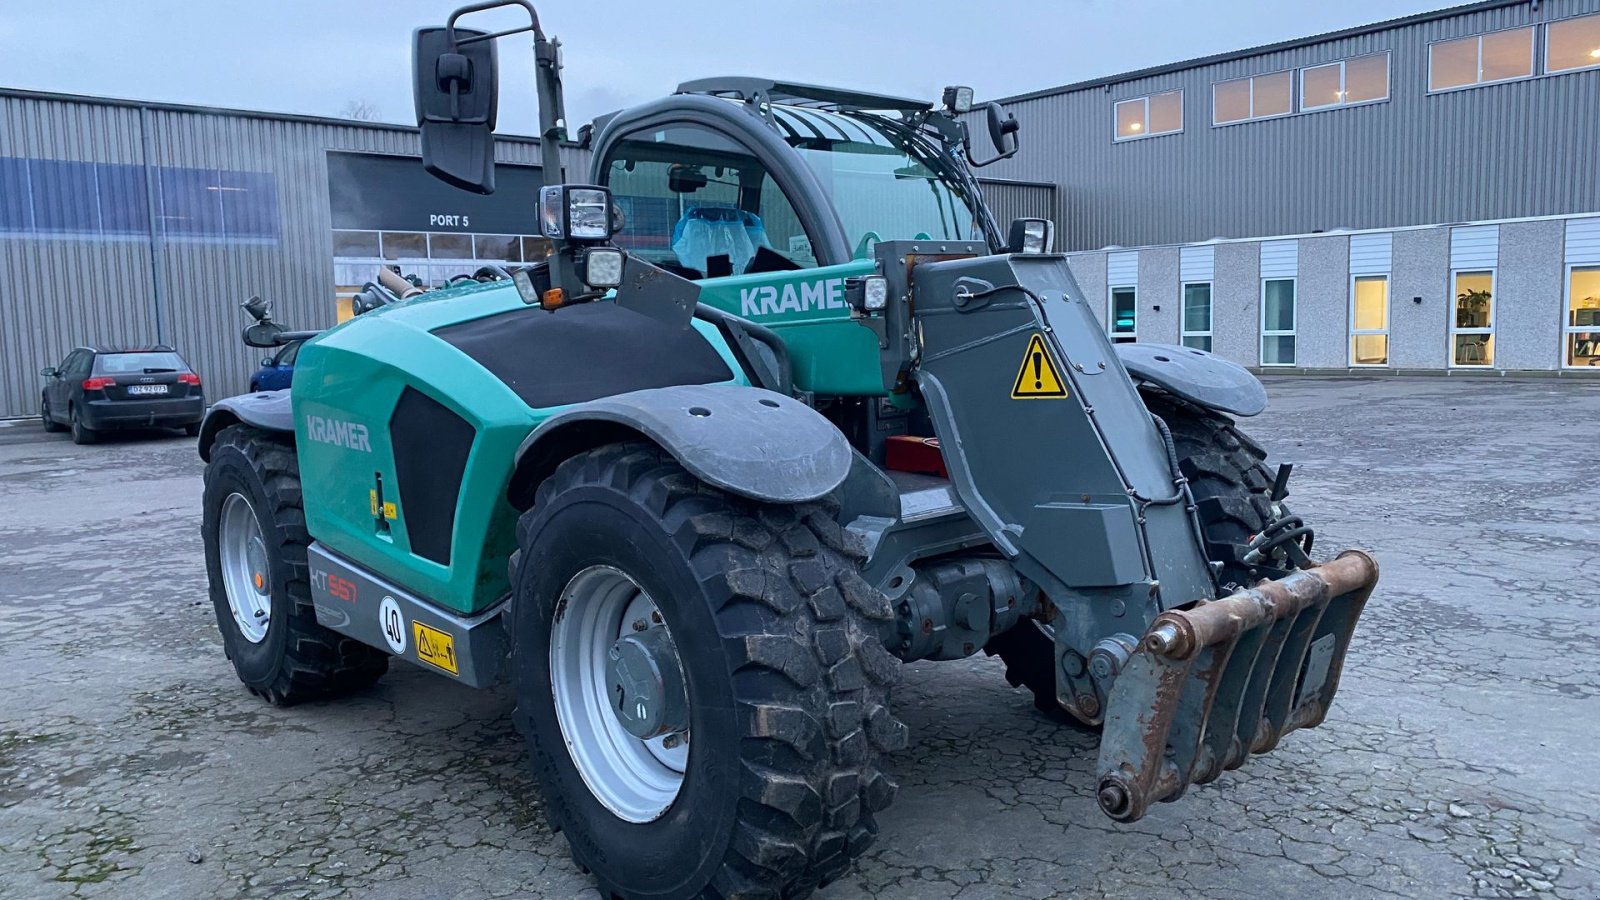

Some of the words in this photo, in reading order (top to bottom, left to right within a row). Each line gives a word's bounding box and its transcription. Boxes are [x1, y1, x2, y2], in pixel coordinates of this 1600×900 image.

[430, 214, 460, 226] PORT
[462, 215, 469, 227] 5
[741, 278, 849, 316] KRAME
[307, 414, 372, 453] KRAMER
[385, 606, 401, 644] 40
